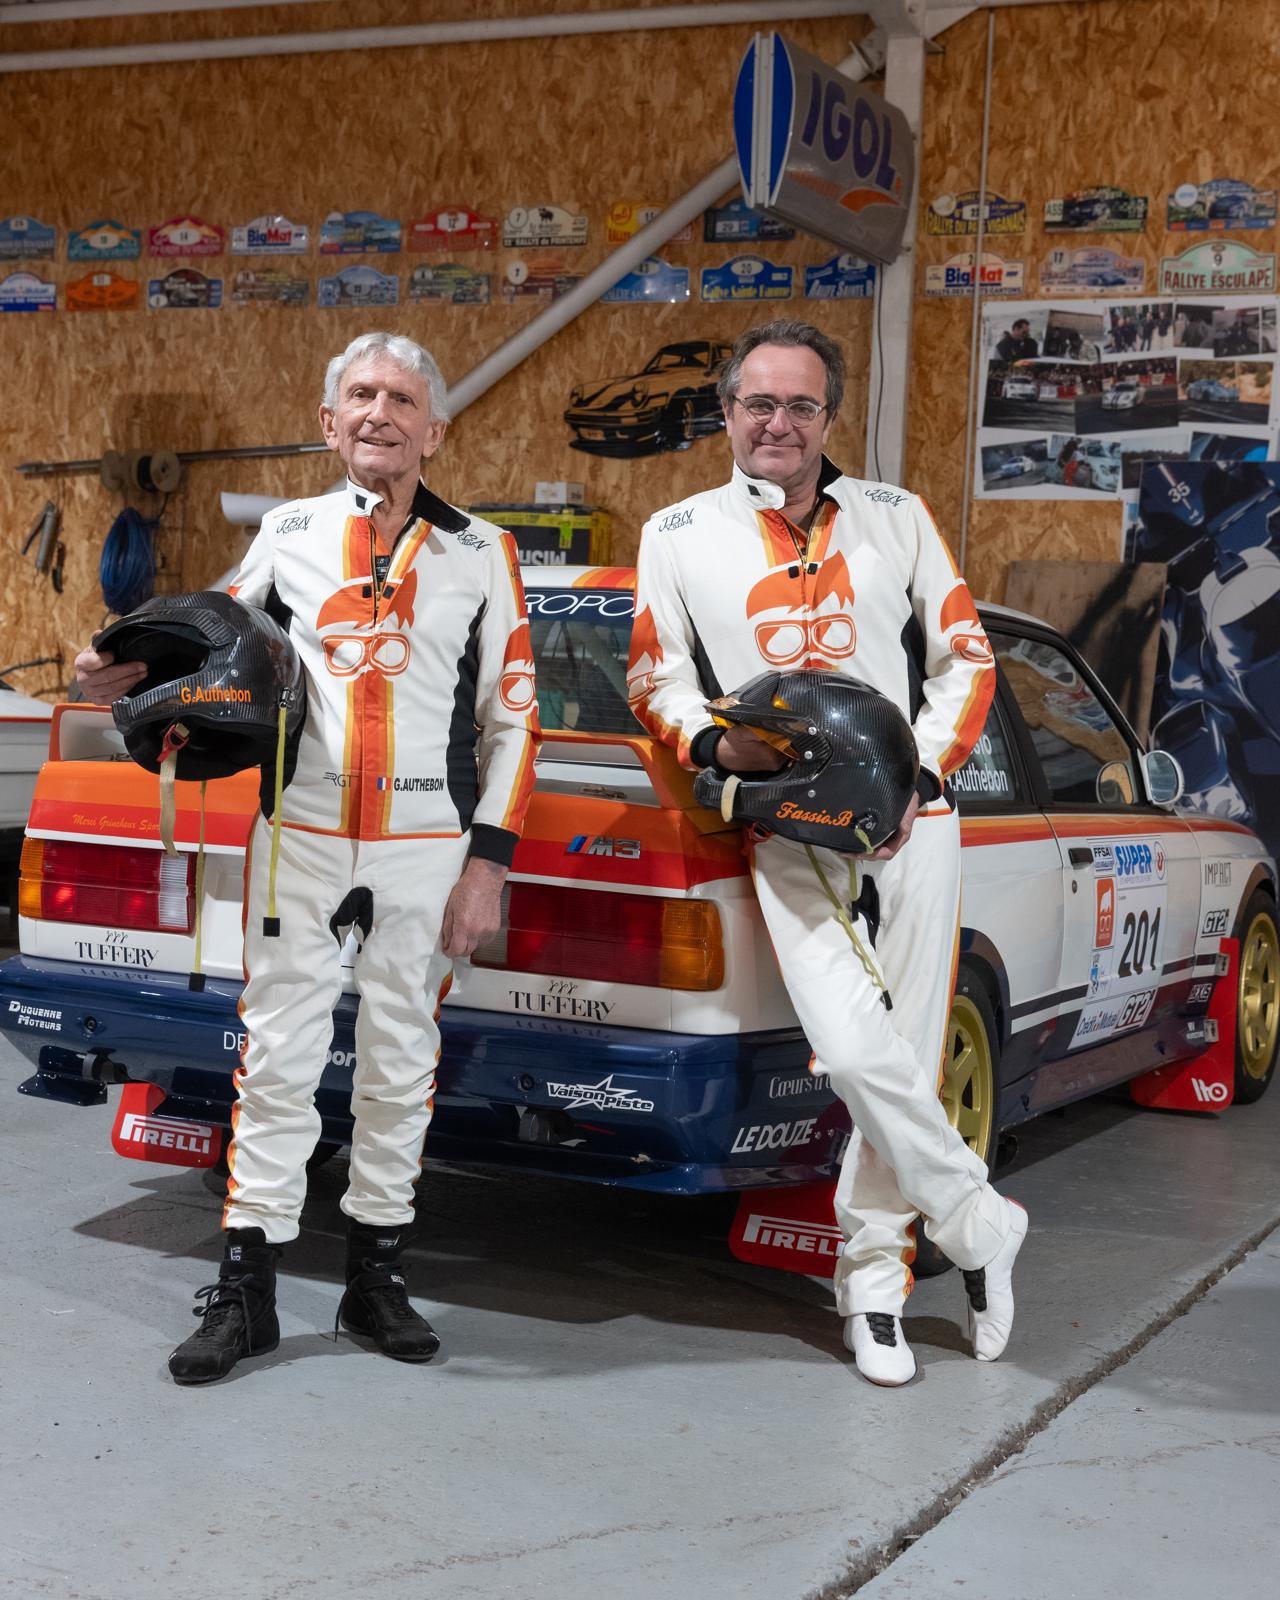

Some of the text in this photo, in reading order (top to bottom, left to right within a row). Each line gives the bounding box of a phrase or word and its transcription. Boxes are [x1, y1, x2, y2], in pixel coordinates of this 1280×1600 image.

[801, 71, 896, 191] IGOL
[247, 228, 292, 247] BigMat
[1213, 253, 1222, 266] 9
[1163, 270, 1207, 289] RALLYE
[1168, 480, 1191, 504] 35
[524, 593, 634, 617] ROPO
[180, 685, 252, 703] G.Authebon
[323, 771, 360, 788] RGT
[393, 777, 445, 792] G.AUTHEBON
[586, 835, 641, 859] M3
[1093, 846, 1111, 858] FFSA
[1114, 843, 1153, 877] SUPER
[1204, 862, 1232, 885] IMPACT
[1118, 906, 1161, 978] 201
[74, 940, 160, 968] TUFFERY
[508, 990, 617, 1022] TUFFERY
[547, 1082, 606, 1101] Vaison
[602, 1095, 655, 1112] Piste
[119, 1112, 213, 1154] PIRELLI
